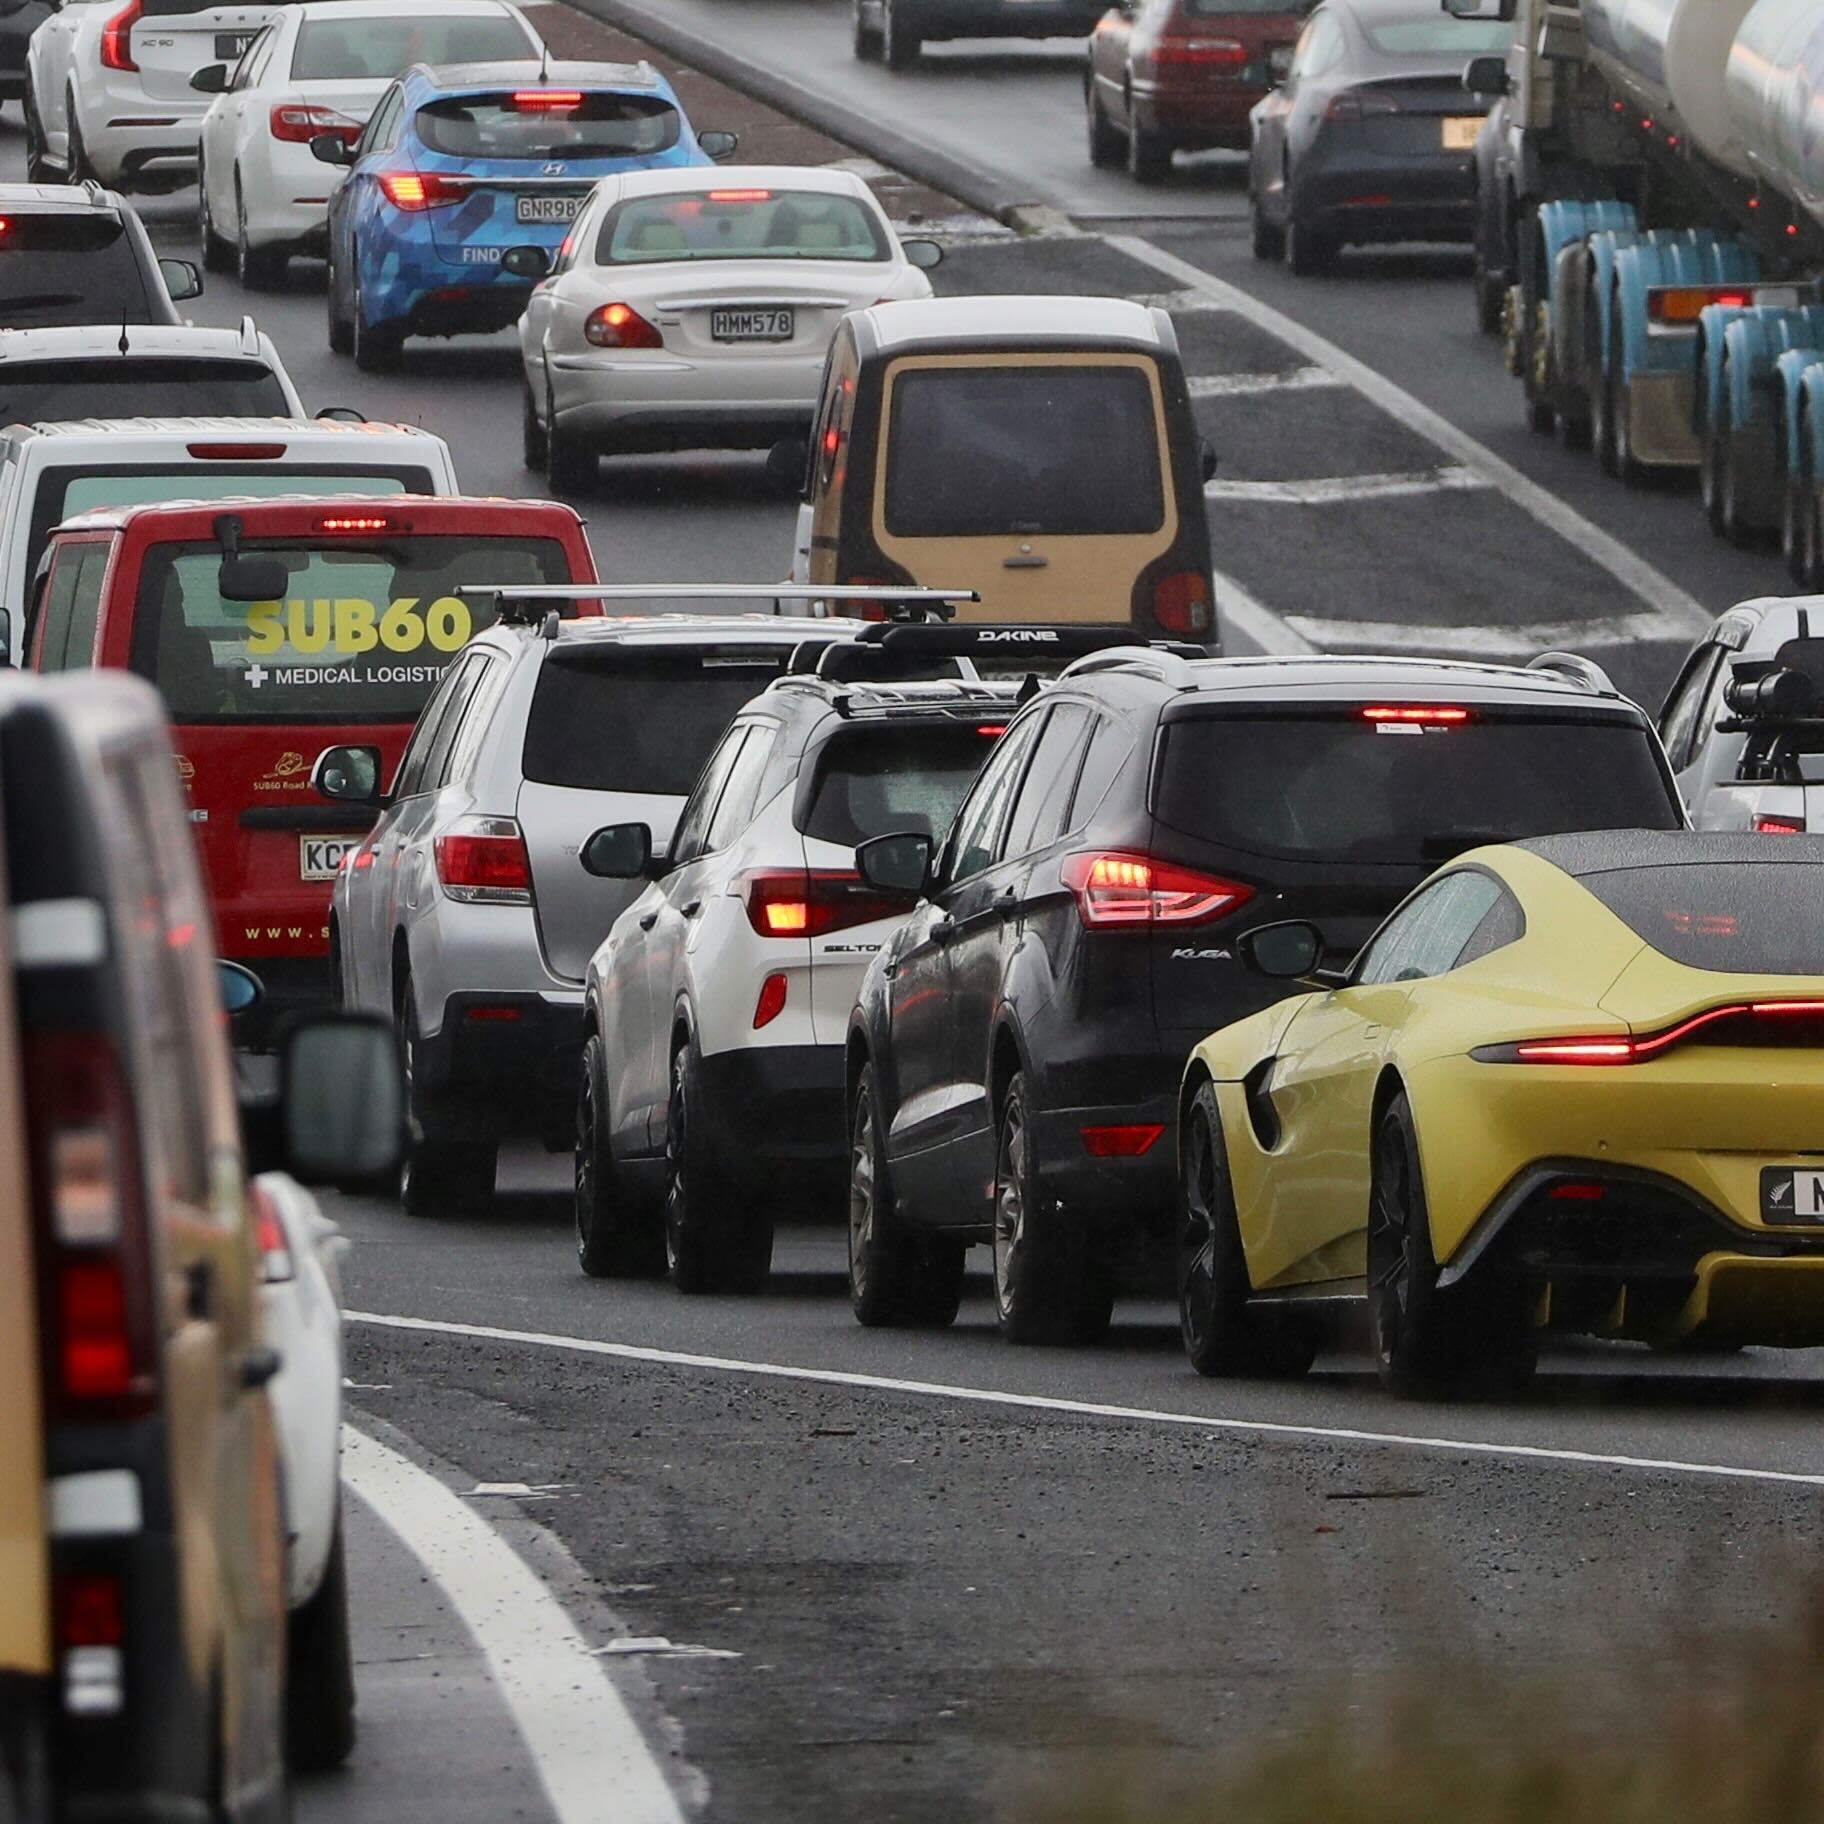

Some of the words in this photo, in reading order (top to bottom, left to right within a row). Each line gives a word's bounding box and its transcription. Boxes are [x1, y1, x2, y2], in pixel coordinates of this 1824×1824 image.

[462, 248, 500, 263] FIND
[716, 311, 791, 337] HMM578
[247, 596, 472, 654] SUB60
[976, 631, 1060, 642] DAKINE
[275, 668, 359, 686] MEDICAL
[366, 664, 447, 684] LOGISTIC
[824, 944, 880, 953] SELTO
[1172, 948, 1232, 960] KUGA
